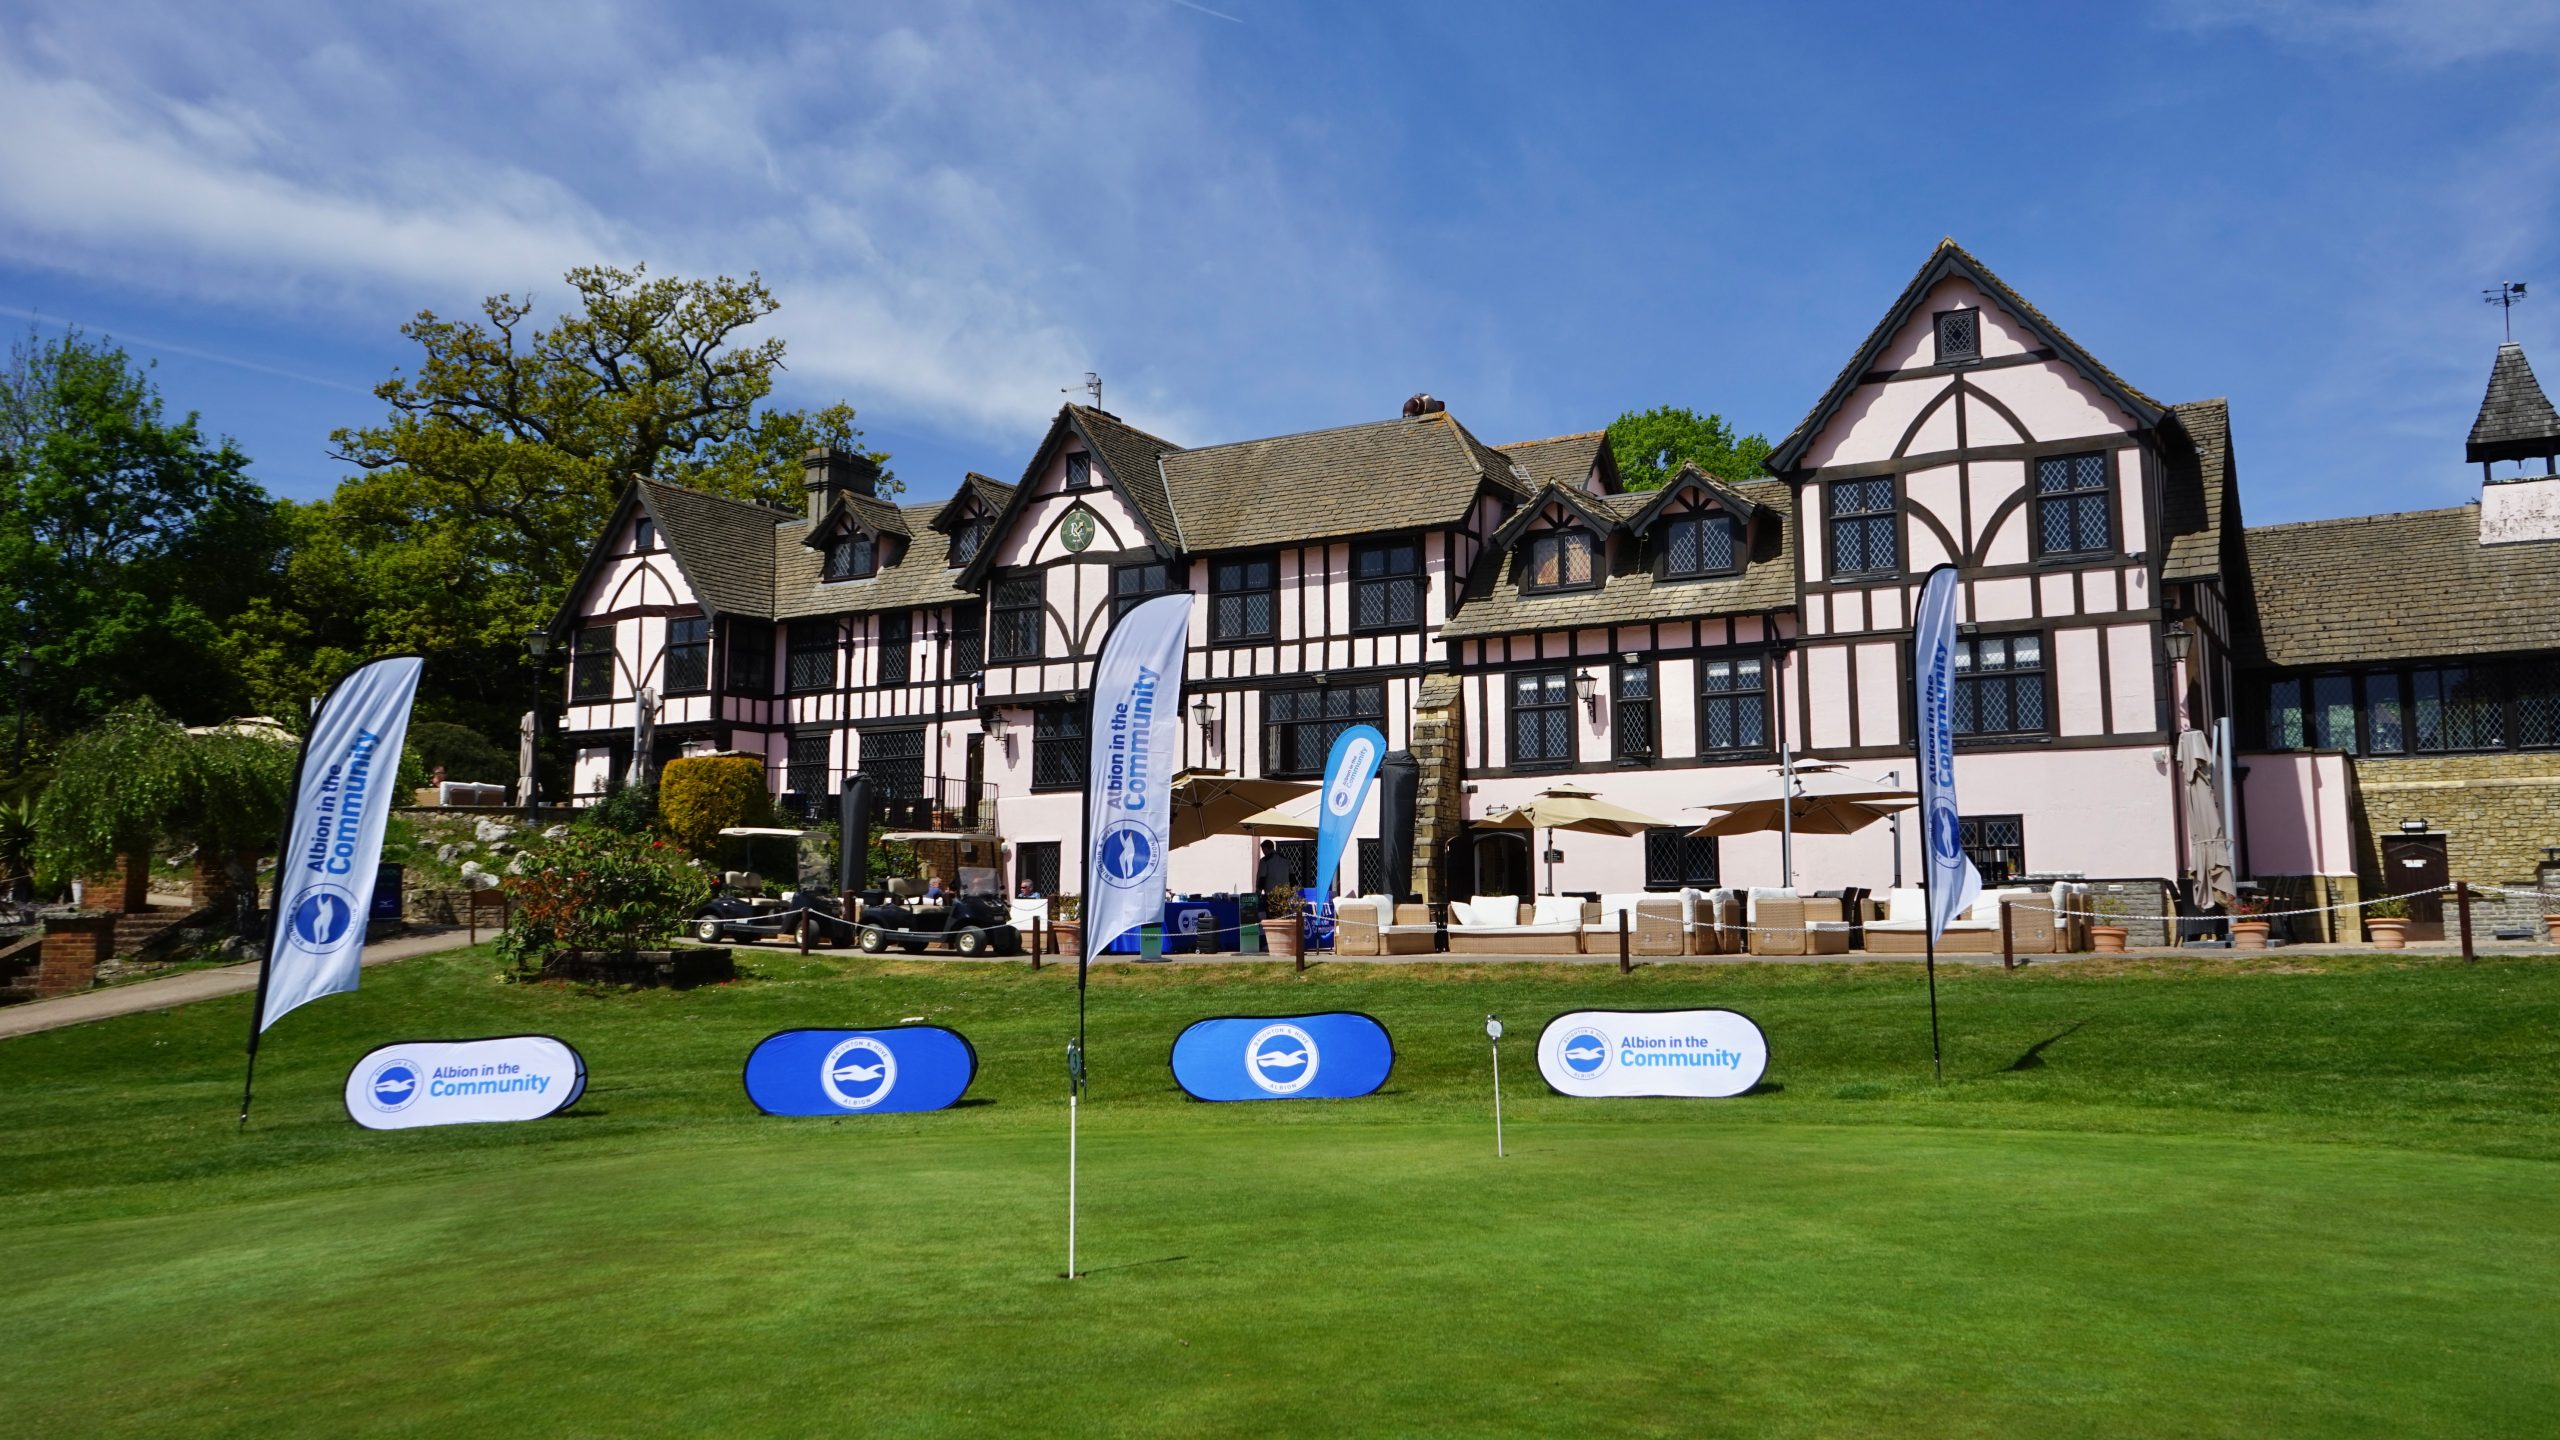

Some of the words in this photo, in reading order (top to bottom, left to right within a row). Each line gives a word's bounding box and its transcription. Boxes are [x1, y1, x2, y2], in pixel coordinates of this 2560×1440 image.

[1926, 674, 1935, 702] the
[1111, 702, 1129, 731] the
[1926, 707, 1935, 724] in
[1934, 638, 1953, 788] Community
[1109, 734, 1126, 750] in
[1123, 665, 1161, 811] Community
[1346, 746, 1368, 789] Community
[1929, 726, 1938, 786] Albion
[320, 764, 342, 793] the
[1107, 753, 1124, 810] Albion
[316, 796, 337, 813] in
[326, 727, 381, 875] Community
[307, 815, 333, 873] Albion
[1150, 841, 1158, 867] ALBION
[1621, 1036, 1667, 1048] Albion
[1669, 1036, 1682, 1048] in
[1685, 1036, 1709, 1048] the
[432, 1066, 478, 1079] Albion
[481, 1064, 494, 1076] in
[497, 1063, 520, 1075] the
[1072, 1053, 1078, 1070] 3
[1620, 1048, 1742, 1070] Community
[430, 1074, 551, 1097] Community
[1270, 1083, 1297, 1091] ALBION
